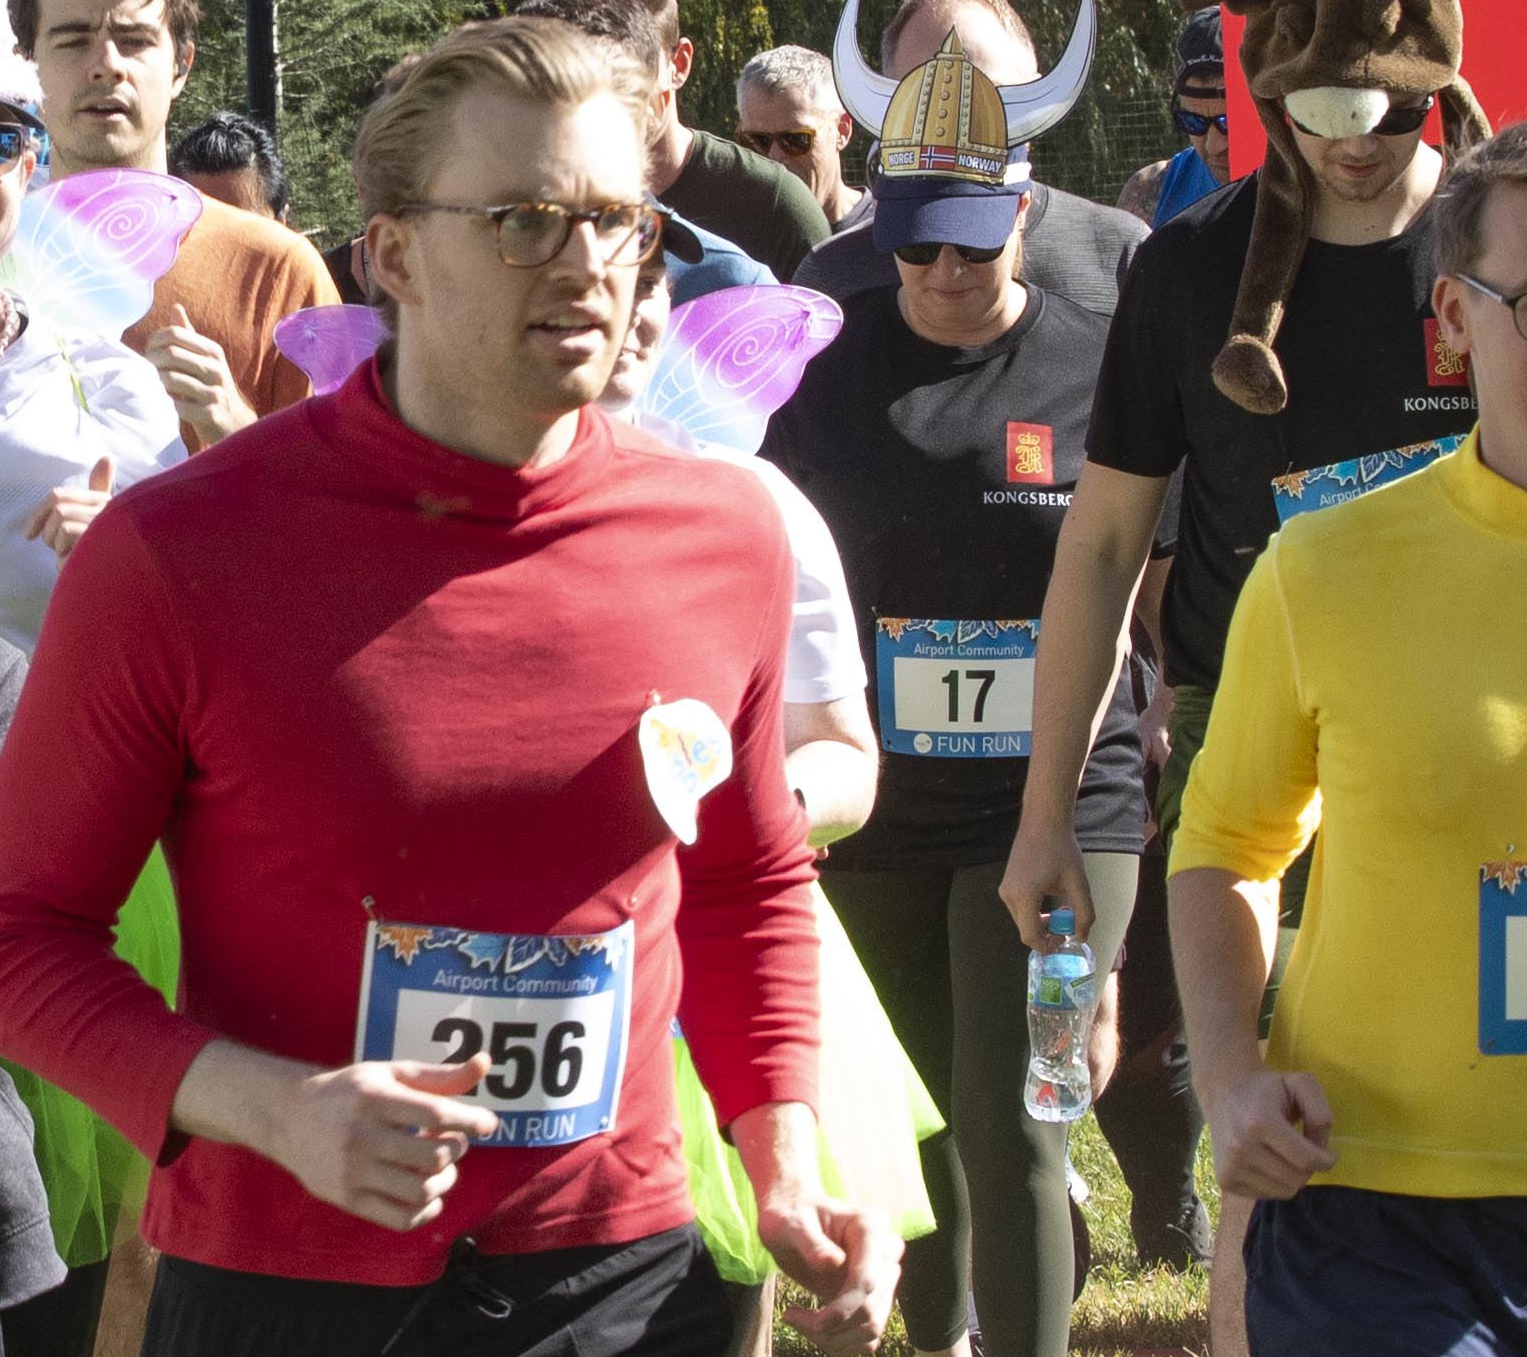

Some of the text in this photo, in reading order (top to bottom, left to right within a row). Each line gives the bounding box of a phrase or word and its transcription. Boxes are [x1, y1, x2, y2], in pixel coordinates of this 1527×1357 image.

[889, 152, 1002, 174] NORGE NORWAY
[1404, 396, 1479, 412] KONGSBE
[1320, 486, 1362, 507] Airport
[913, 643, 1025, 658] Airport Community
[941, 669, 996, 723] 17
[937, 736, 1021, 753] FUN RUN
[433, 969, 599, 995] Airport Community
[432, 1017, 585, 1101] 256
[524, 1113, 576, 1140] RUN
